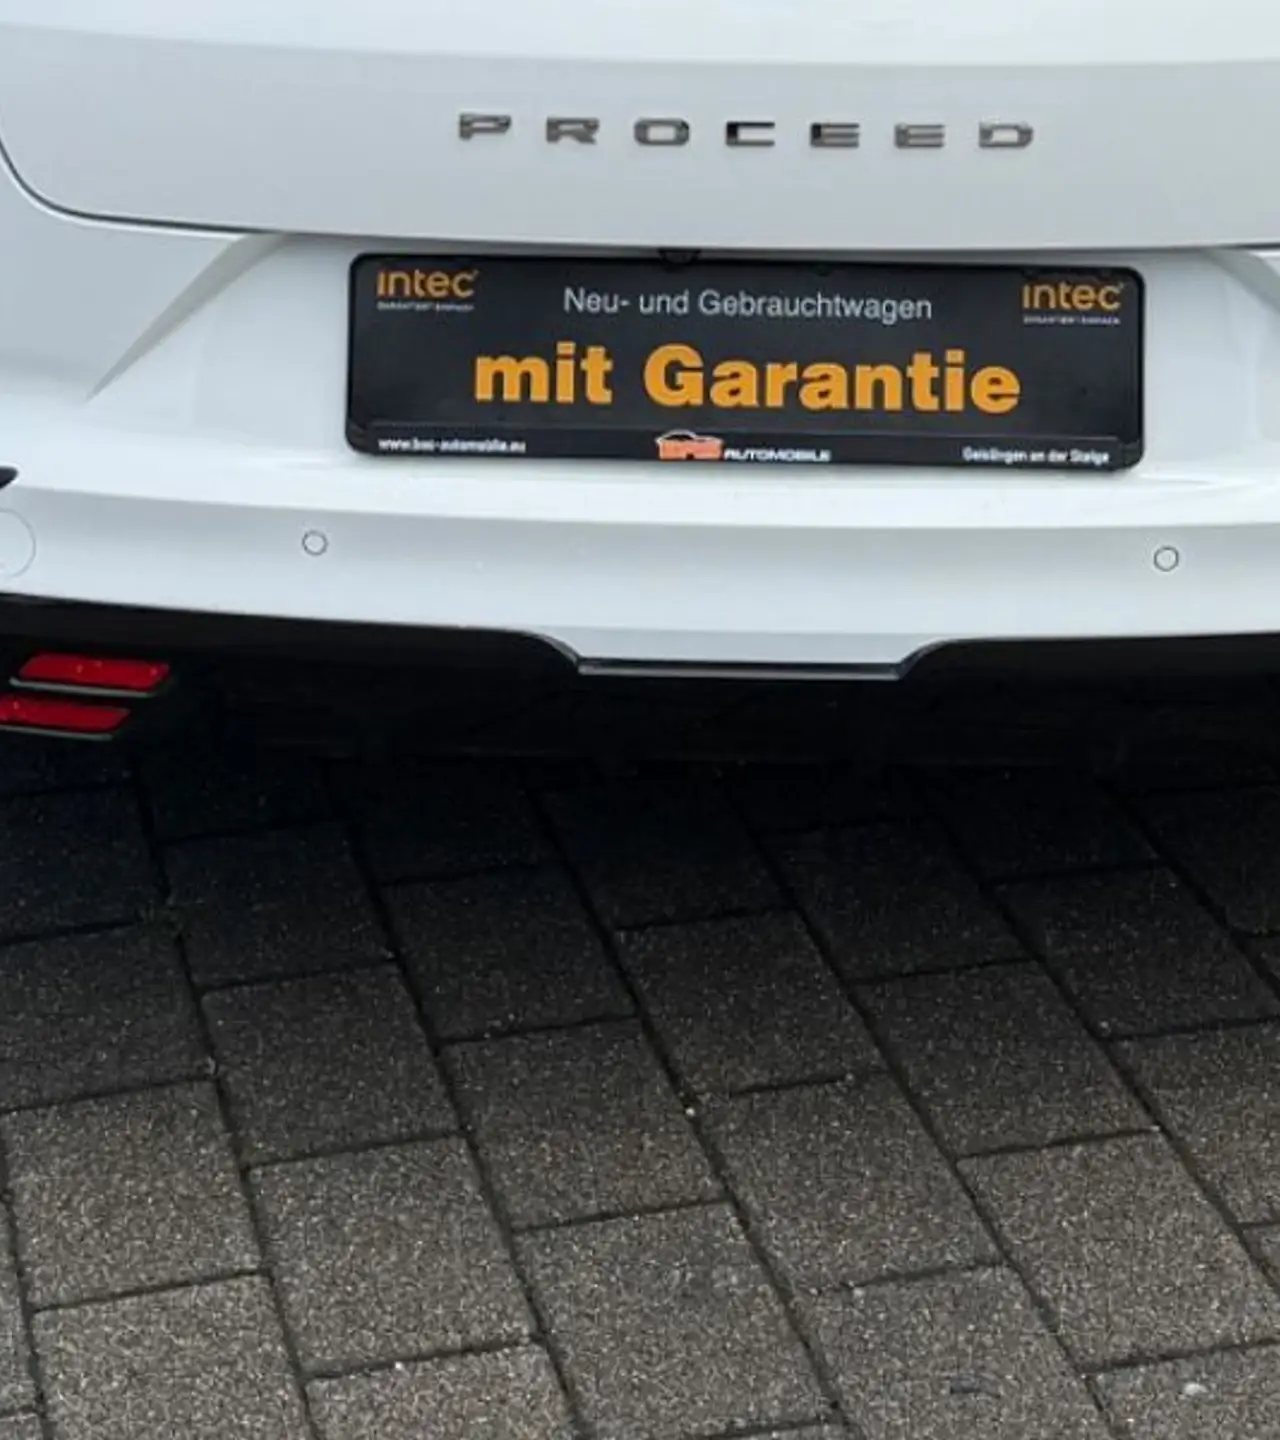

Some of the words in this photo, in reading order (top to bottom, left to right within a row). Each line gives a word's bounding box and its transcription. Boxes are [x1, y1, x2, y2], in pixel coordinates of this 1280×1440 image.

[458, 112, 1034, 149] PROCEED
[377, 269, 477, 298] intec
[1023, 281, 1122, 311] intec
[564, 288, 629, 313] Neu-
[639, 290, 690, 315] und
[698, 290, 933, 325] Gebrauchtwagen
[476, 341, 613, 404] mit
[644, 343, 1021, 415] Garantie
[724, 448, 832, 462] AUTOMOBILE
